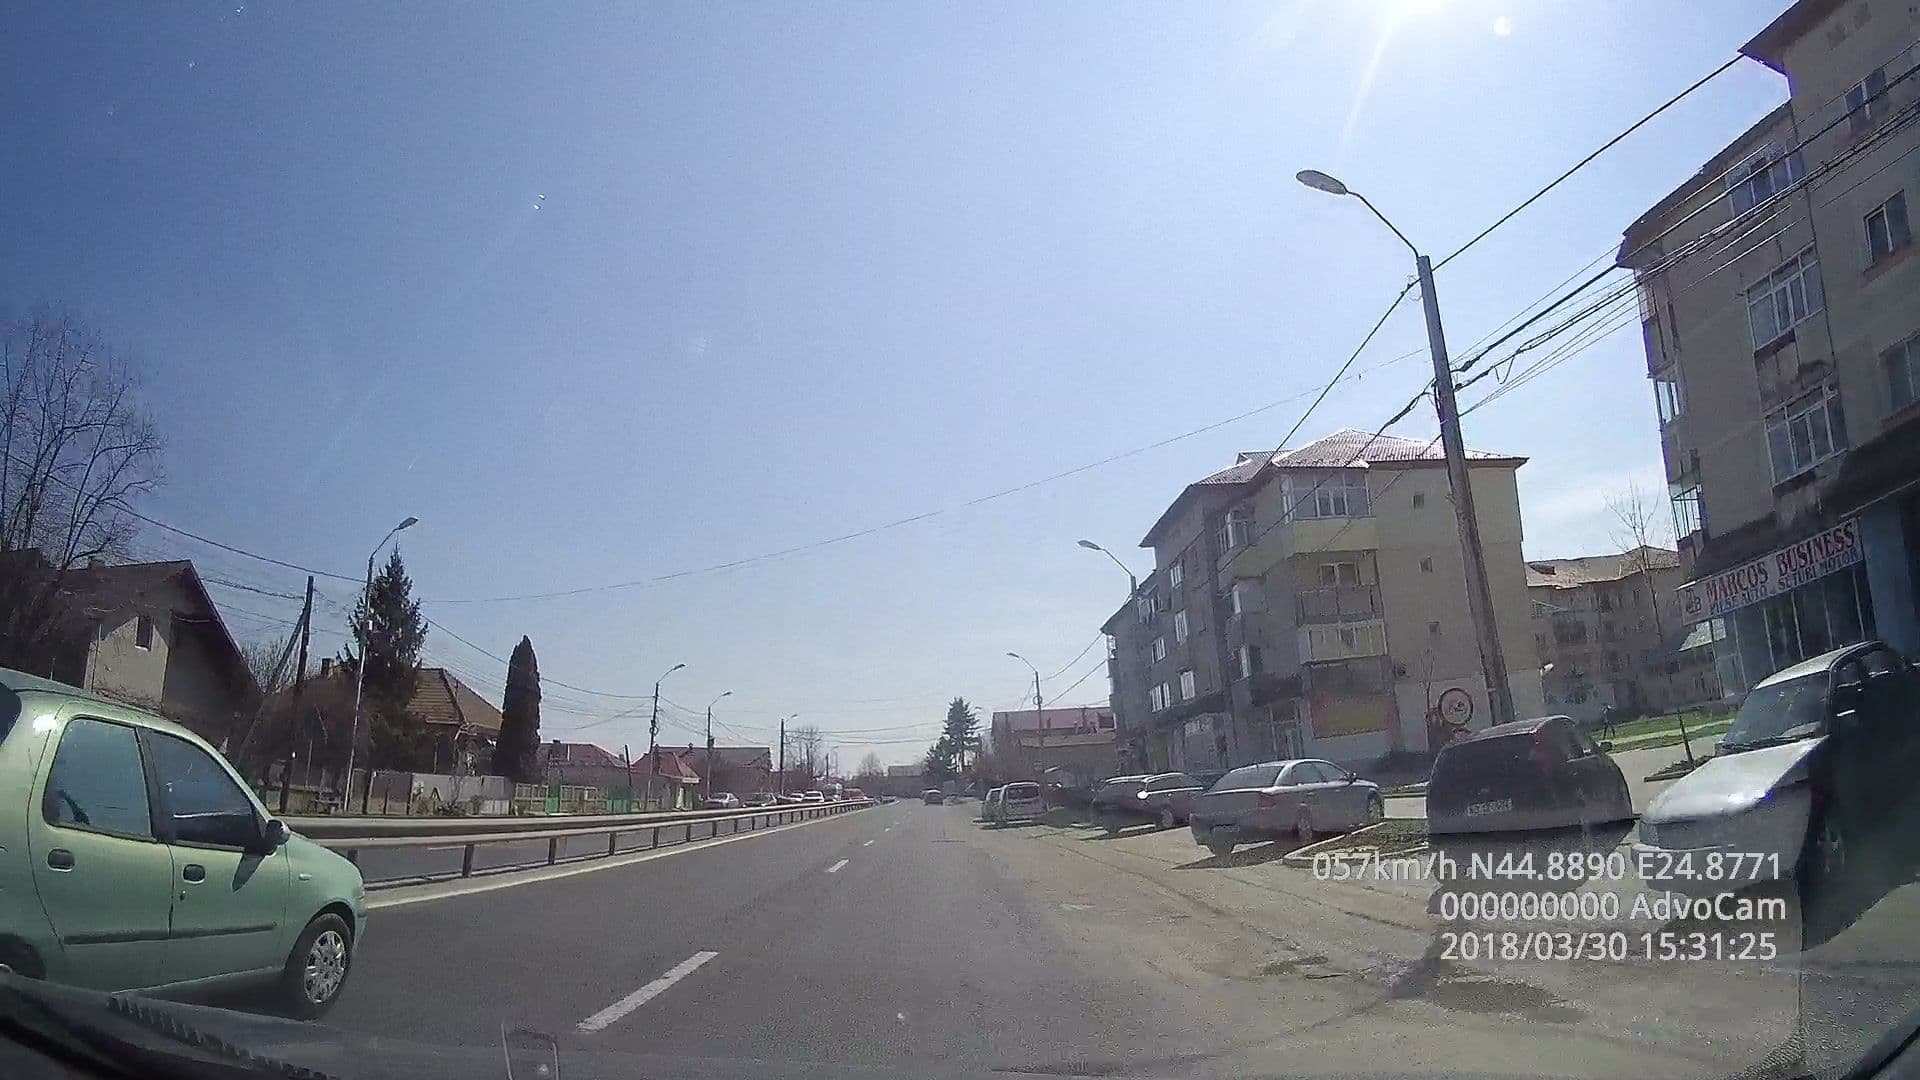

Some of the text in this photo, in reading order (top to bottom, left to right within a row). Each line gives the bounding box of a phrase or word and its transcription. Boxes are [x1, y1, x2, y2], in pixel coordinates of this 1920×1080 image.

[1706, 562, 1769, 601] MARCOS
[1776, 522, 1855, 577] BUSINESS
[1741, 586, 1768, 605] AUTO
